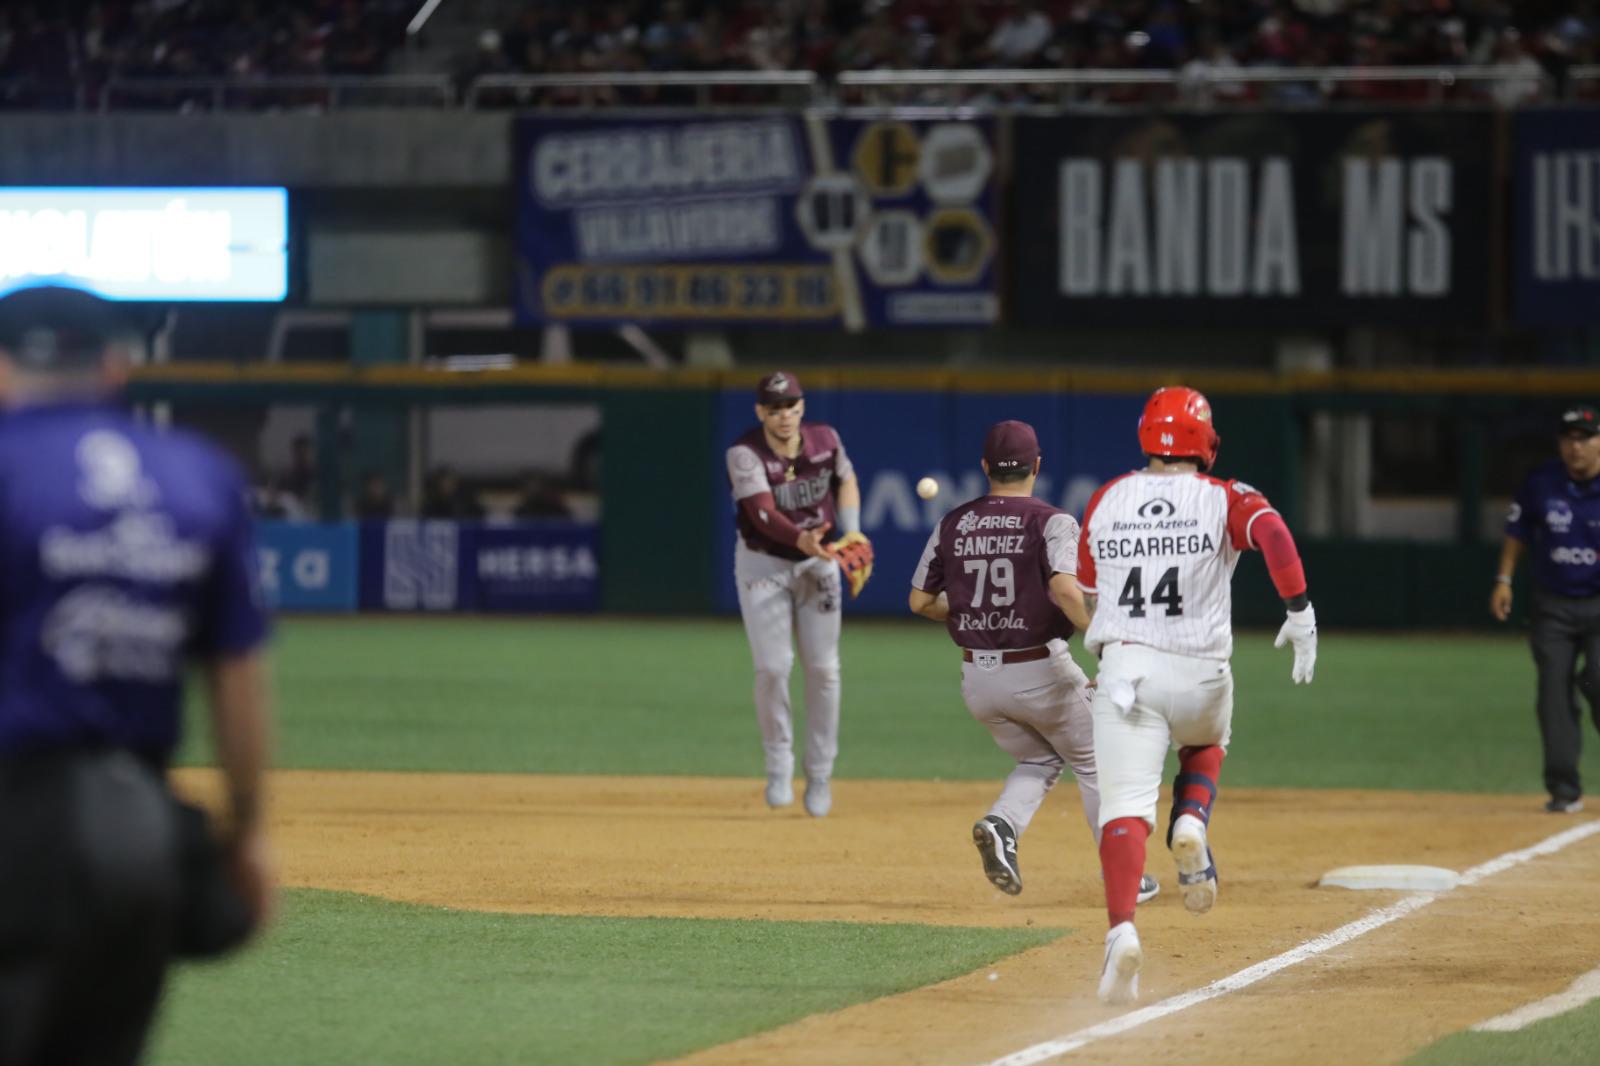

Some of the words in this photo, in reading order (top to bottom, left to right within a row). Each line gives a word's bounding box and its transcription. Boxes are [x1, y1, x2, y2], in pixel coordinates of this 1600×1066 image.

[1060, 157, 1299, 296] BANDA
[1342, 157, 1452, 296] MS
[977, 515, 1025, 529] ARIEL
[1112, 521, 1152, 532] Banco
[1154, 518, 1198, 530] Azteca
[954, 535, 1025, 557] SANCHEZ
[1097, 533, 1215, 560] ESCARREGA
[963, 558, 1016, 608] 79
[1118, 566, 1183, 618] 44
